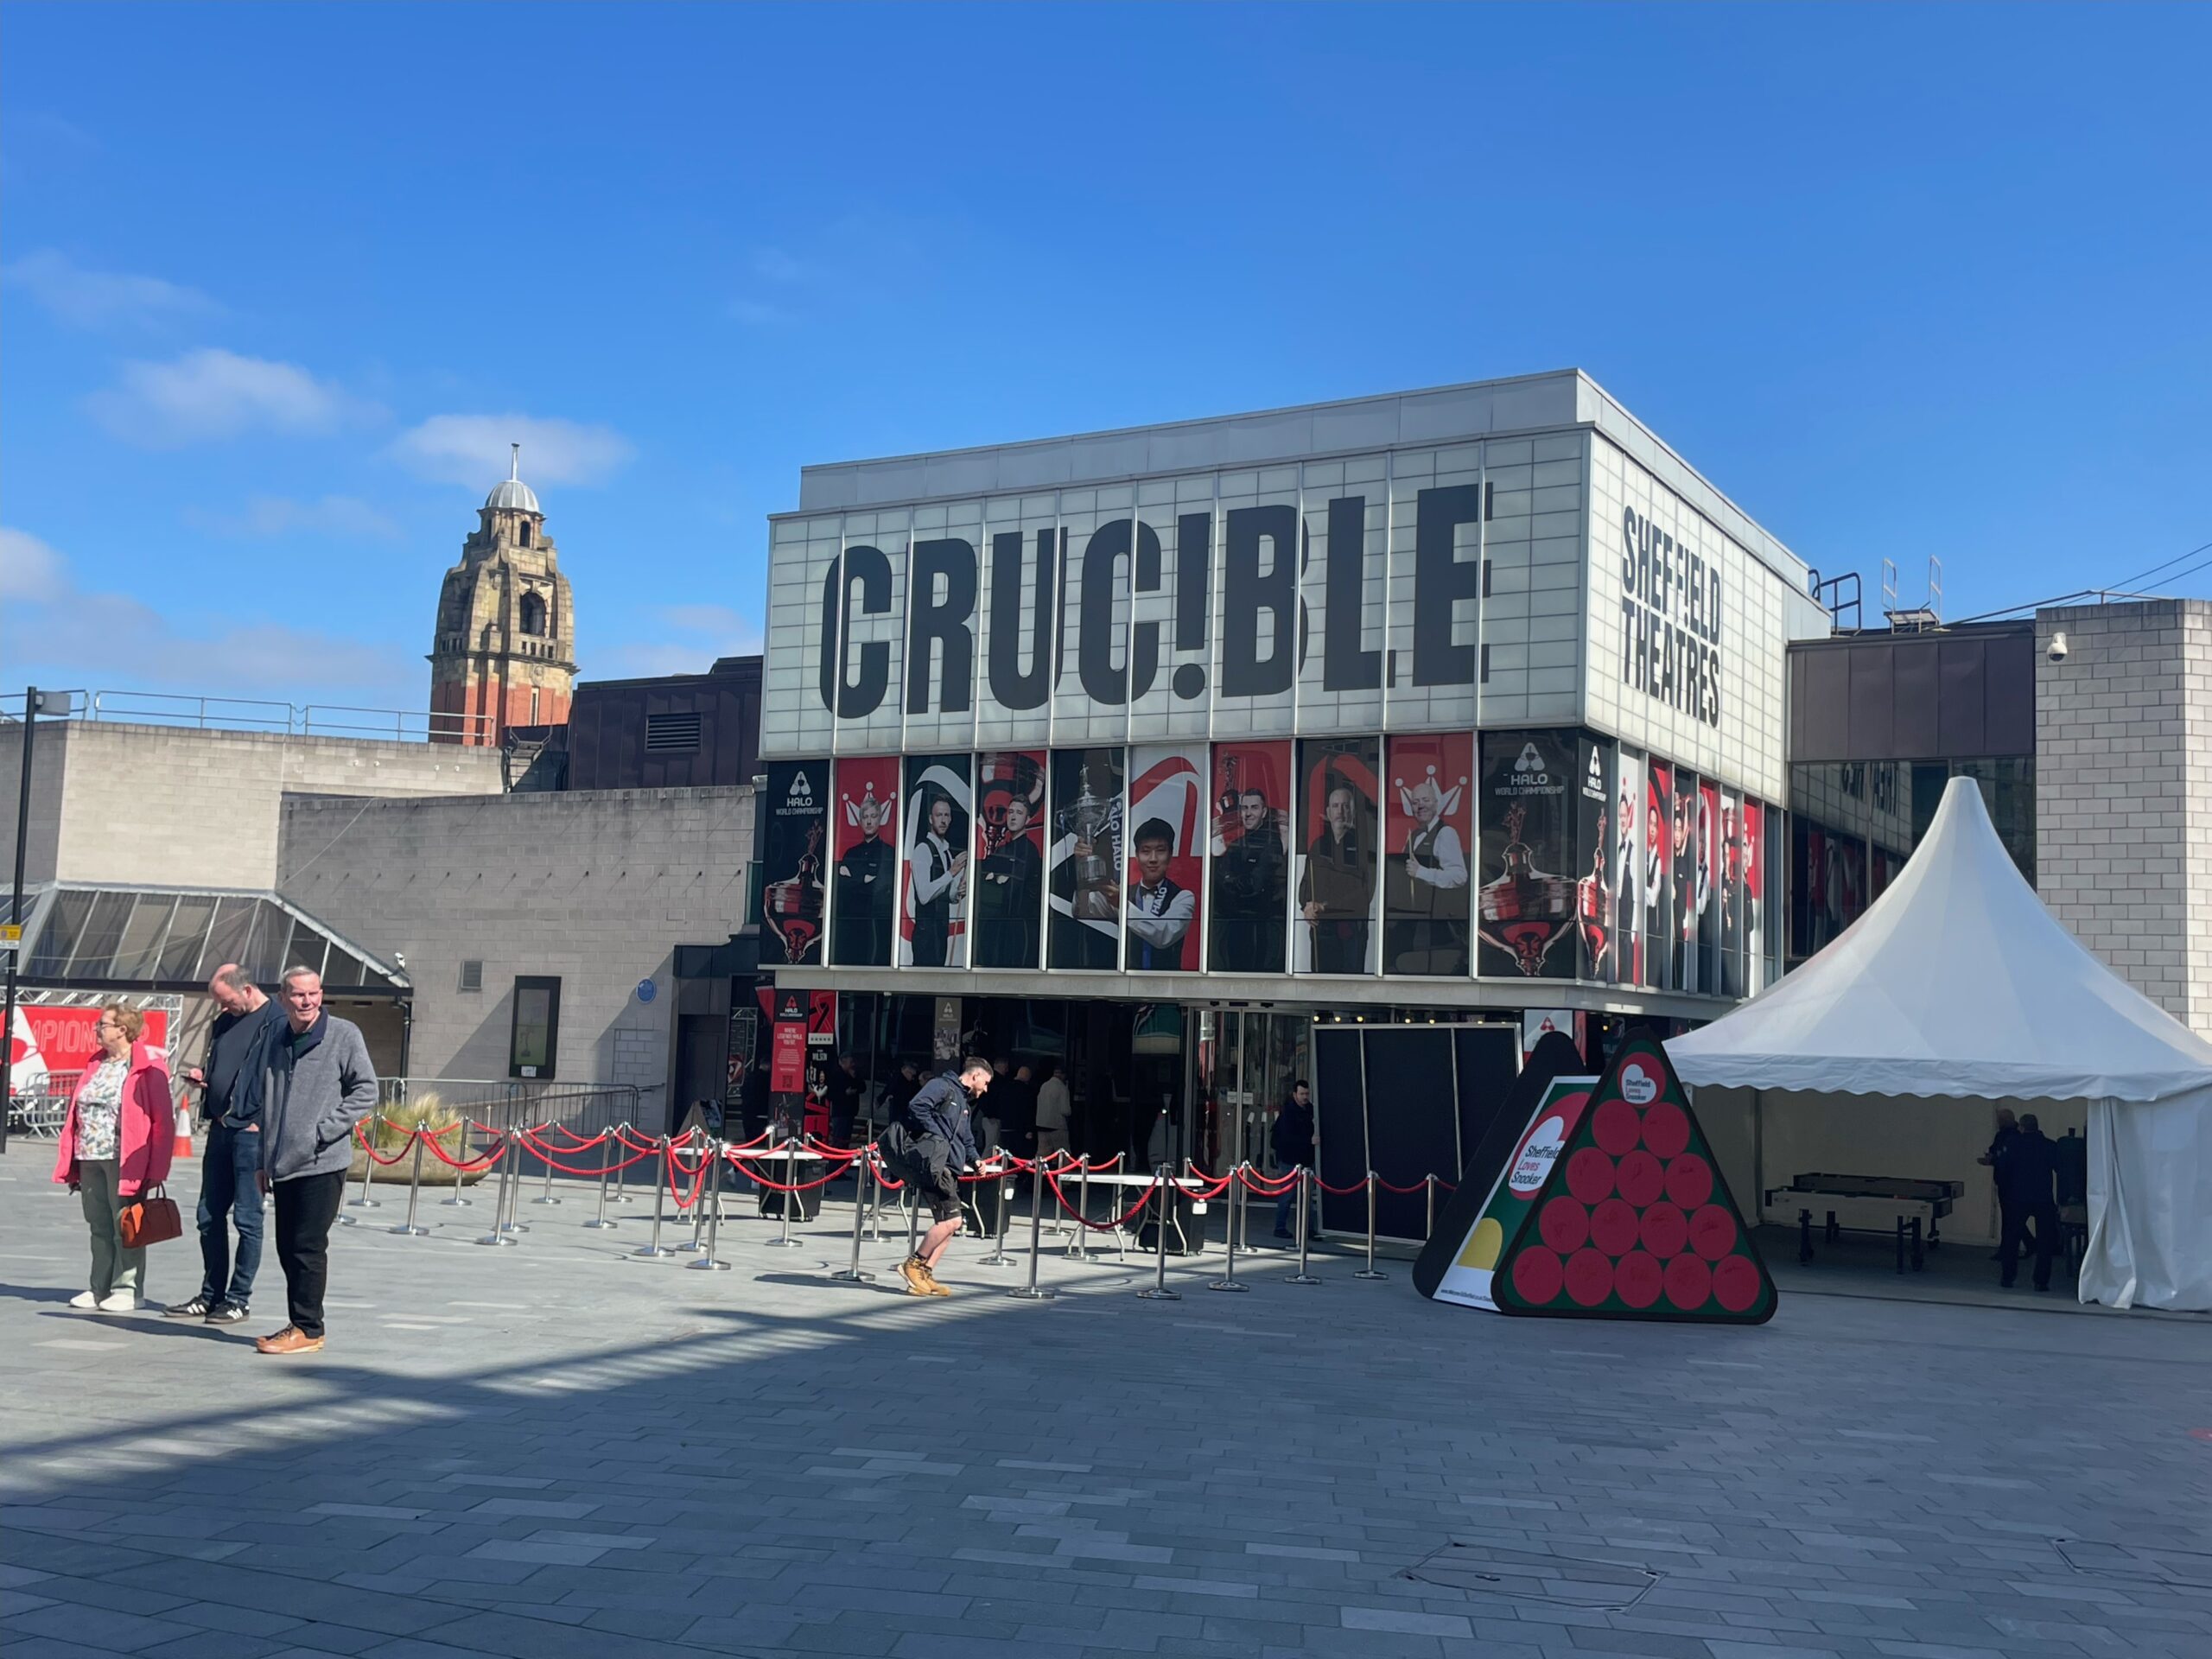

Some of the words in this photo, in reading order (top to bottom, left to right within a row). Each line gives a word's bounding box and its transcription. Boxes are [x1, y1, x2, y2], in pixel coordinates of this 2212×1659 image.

[1622, 595, 1720, 728] THEATRES
[1510, 773, 1548, 785] HALO
[1587, 775, 1602, 790] HALO
[1495, 786, 1517, 796] WORLD
[1518, 785, 1565, 795] CHAMPIONSHIP
[786, 797, 813, 807] HALO
[1109, 806, 1121, 832] ALO
[1111, 835, 1122, 872] HALO
[1150, 887, 1168, 914] HALO
[1517, 1159, 1541, 1171] Loves
[1511, 1171, 1541, 1185] Snooker
